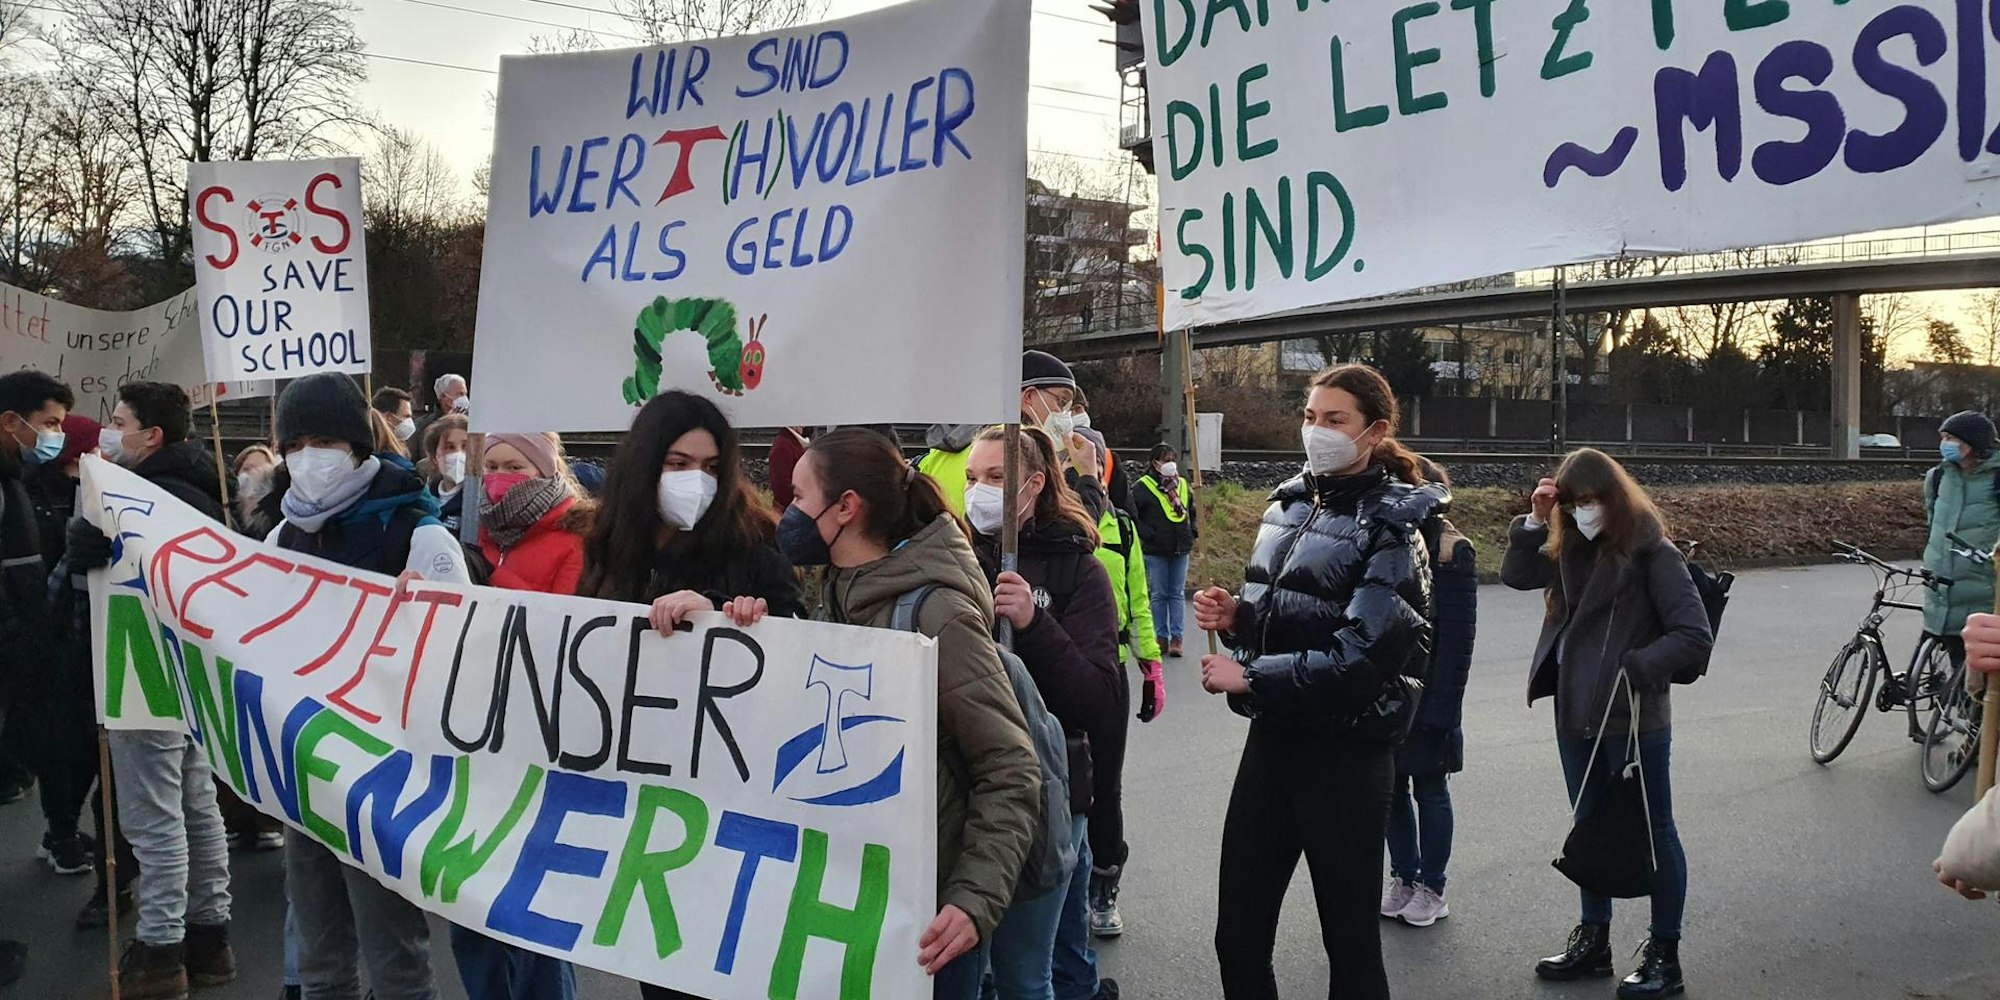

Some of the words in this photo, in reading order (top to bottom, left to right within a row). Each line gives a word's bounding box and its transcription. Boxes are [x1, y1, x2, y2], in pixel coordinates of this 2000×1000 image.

[626, 46, 710, 119] WIR
[736, 30, 849, 98] SIND
[529, 68, 975, 218] WERT(H)VOLLER
[1167, 63, 1279, 181] DIE
[262, 258, 354, 292] SAVE
[582, 220, 686, 282] ALS
[726, 205, 853, 275] GELD
[1176, 171, 1365, 299] SIND.
[66, 326, 150, 351] unsere
[212, 294, 292, 338] OUR
[241, 329, 366, 373] SCHOOL
[80, 375, 108, 394] es
[150, 526, 463, 730] RETTET
[441, 600, 765, 783] UNSER
[104, 594, 890, 1000] NONNENWERTH
